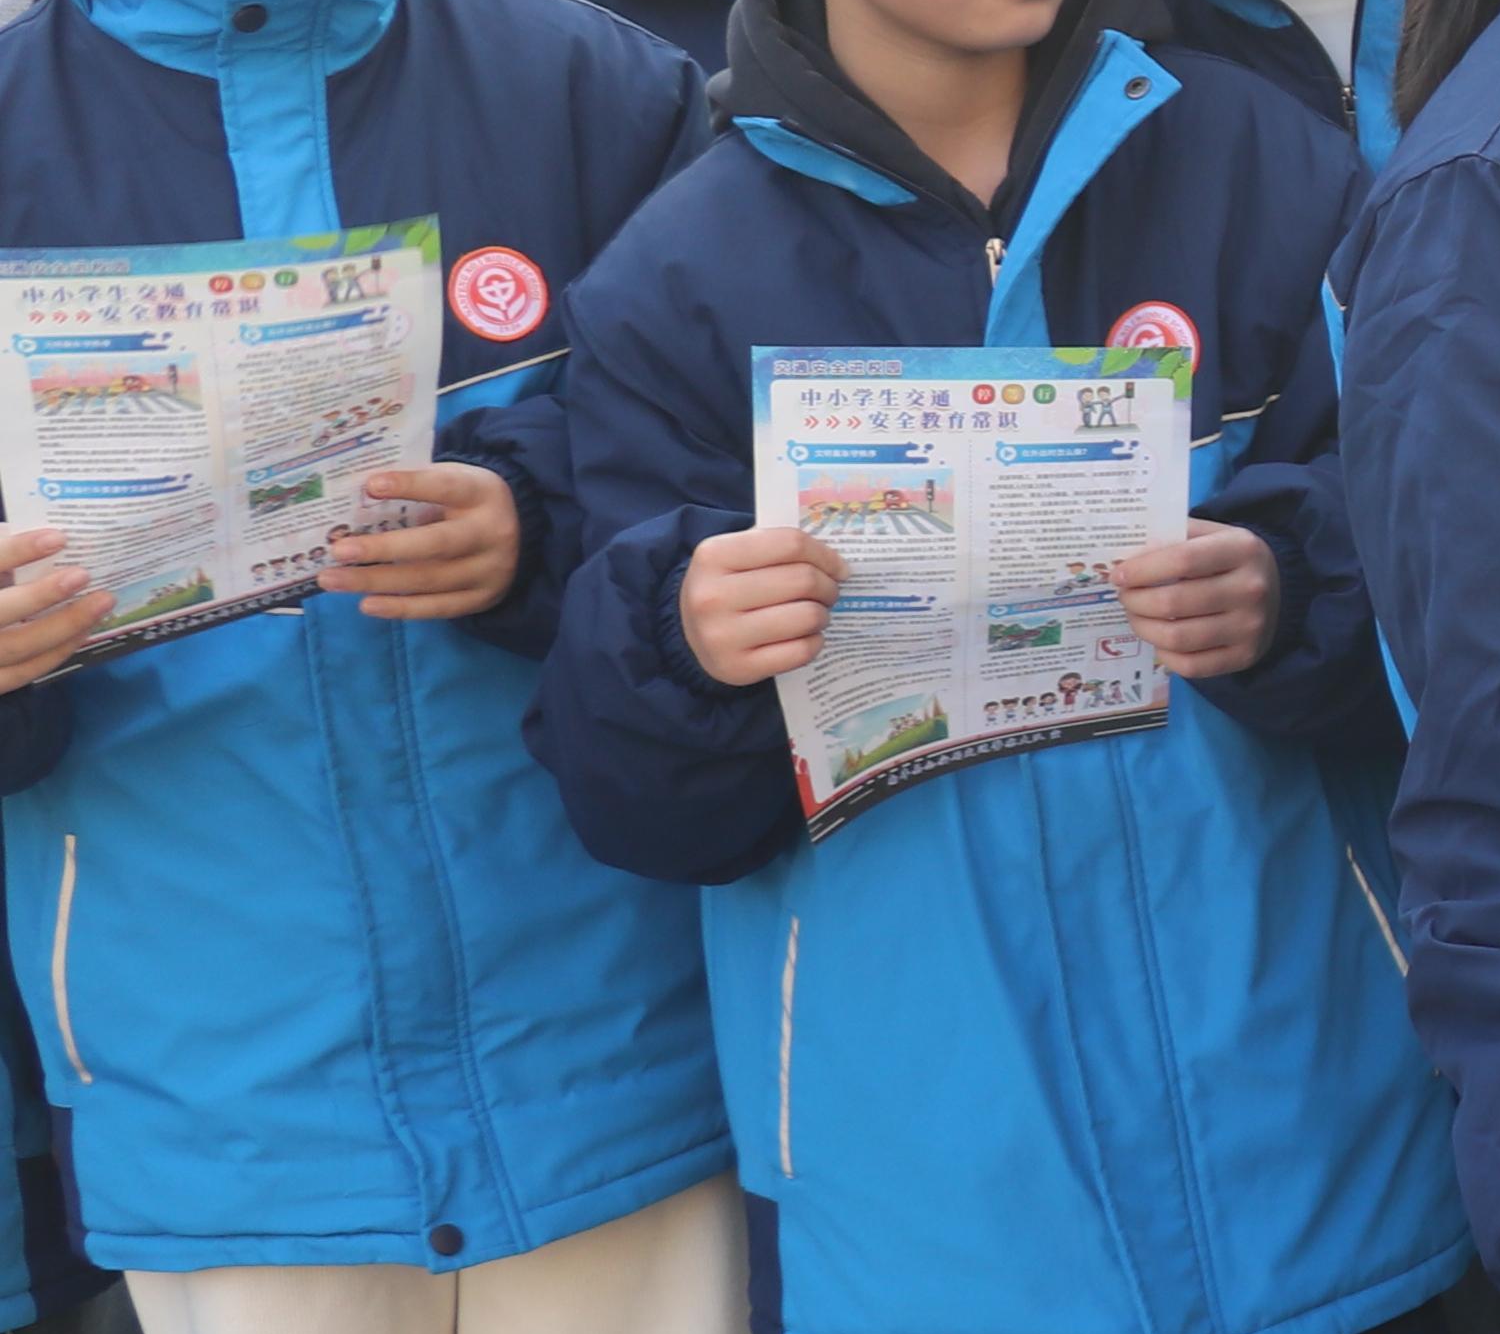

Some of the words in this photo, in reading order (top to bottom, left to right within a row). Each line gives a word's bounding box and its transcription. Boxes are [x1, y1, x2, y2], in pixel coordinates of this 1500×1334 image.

[799, 387, 952, 409] 中小学生交通
[868, 411, 1020, 431] 安全教育常识
